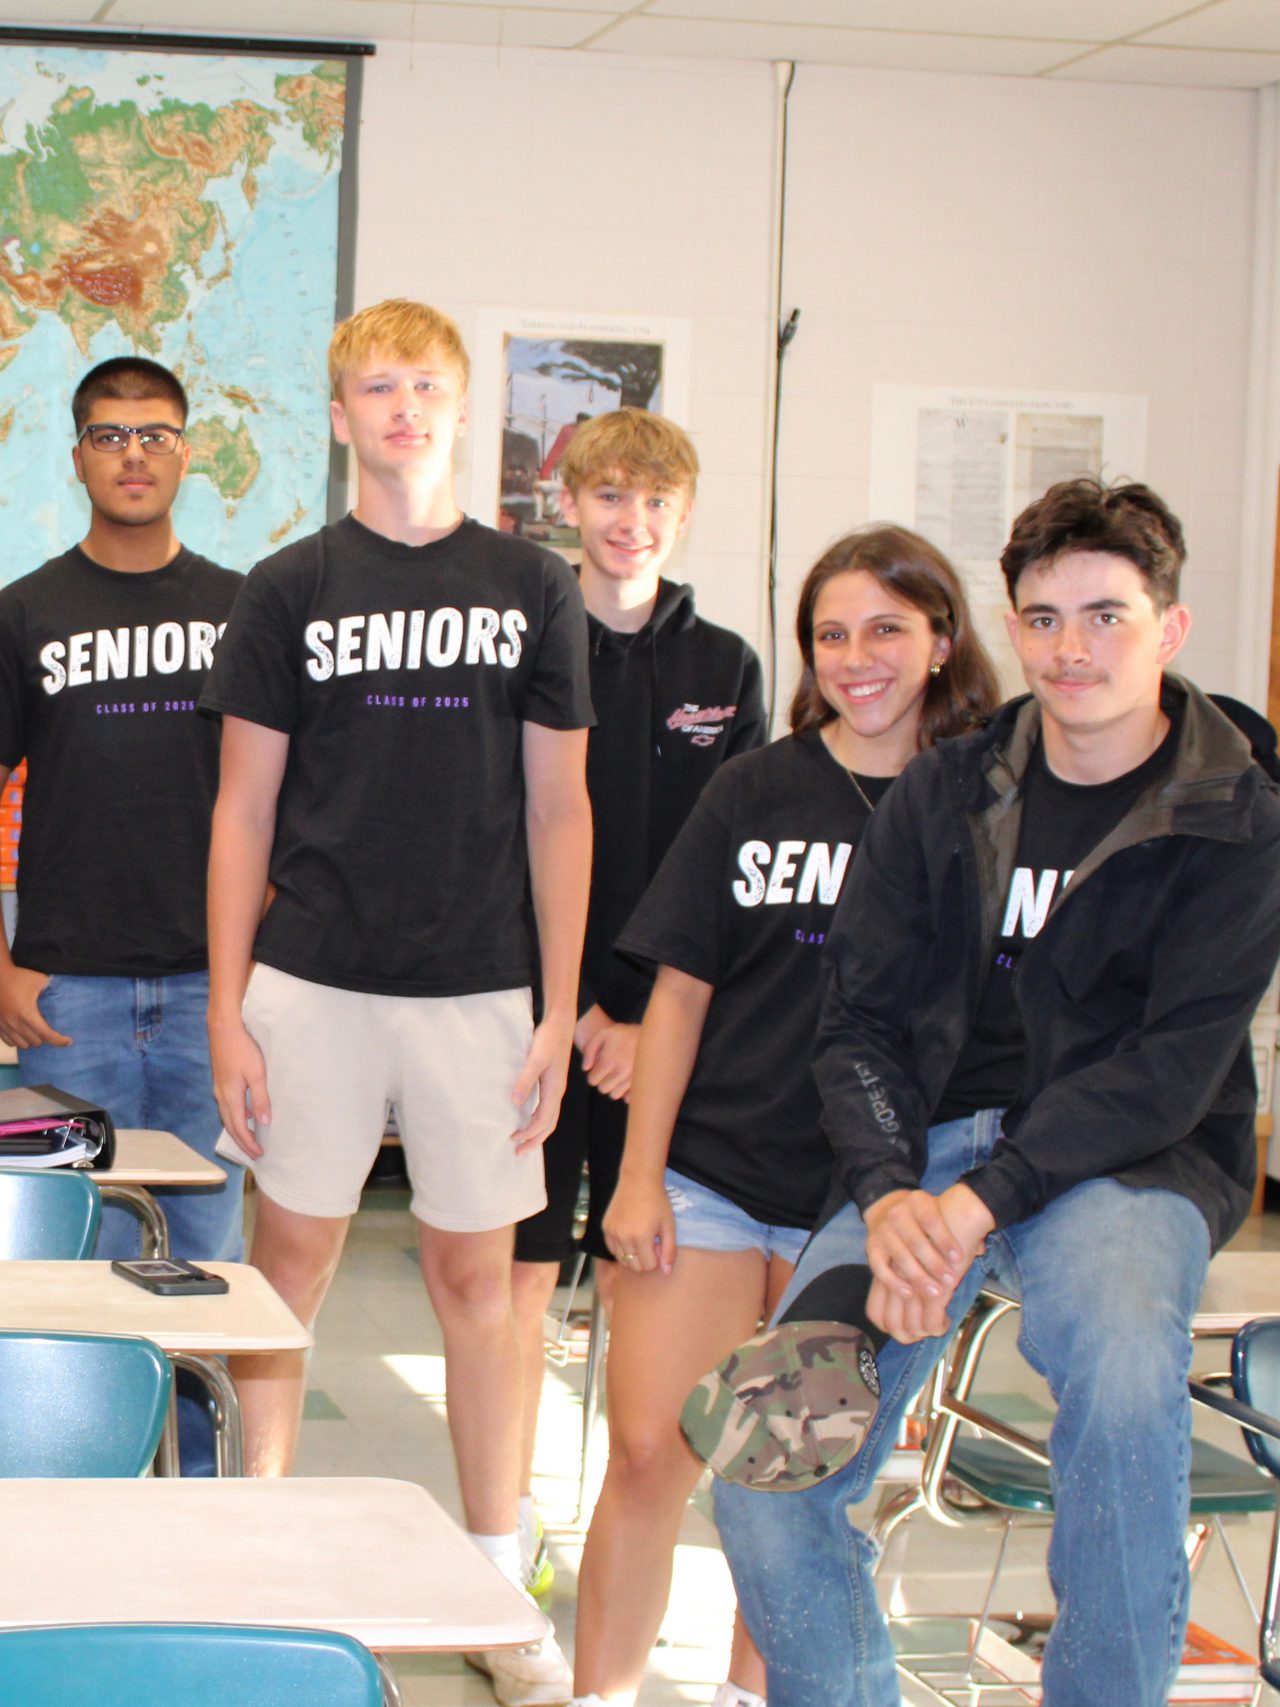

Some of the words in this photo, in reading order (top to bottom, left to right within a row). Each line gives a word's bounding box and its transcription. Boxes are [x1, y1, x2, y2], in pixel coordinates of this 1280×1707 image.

[39, 621, 228, 696] SENIOR
[304, 606, 528, 682] SENIORS
[95, 703, 136, 715] CLASS
[142, 702, 158, 713] OF
[164, 701, 196, 712] 2025
[367, 695, 405, 707] CLASS
[412, 697, 427, 708] OF
[435, 697, 470, 708] 2025
[1001, 866, 1075, 938] N
